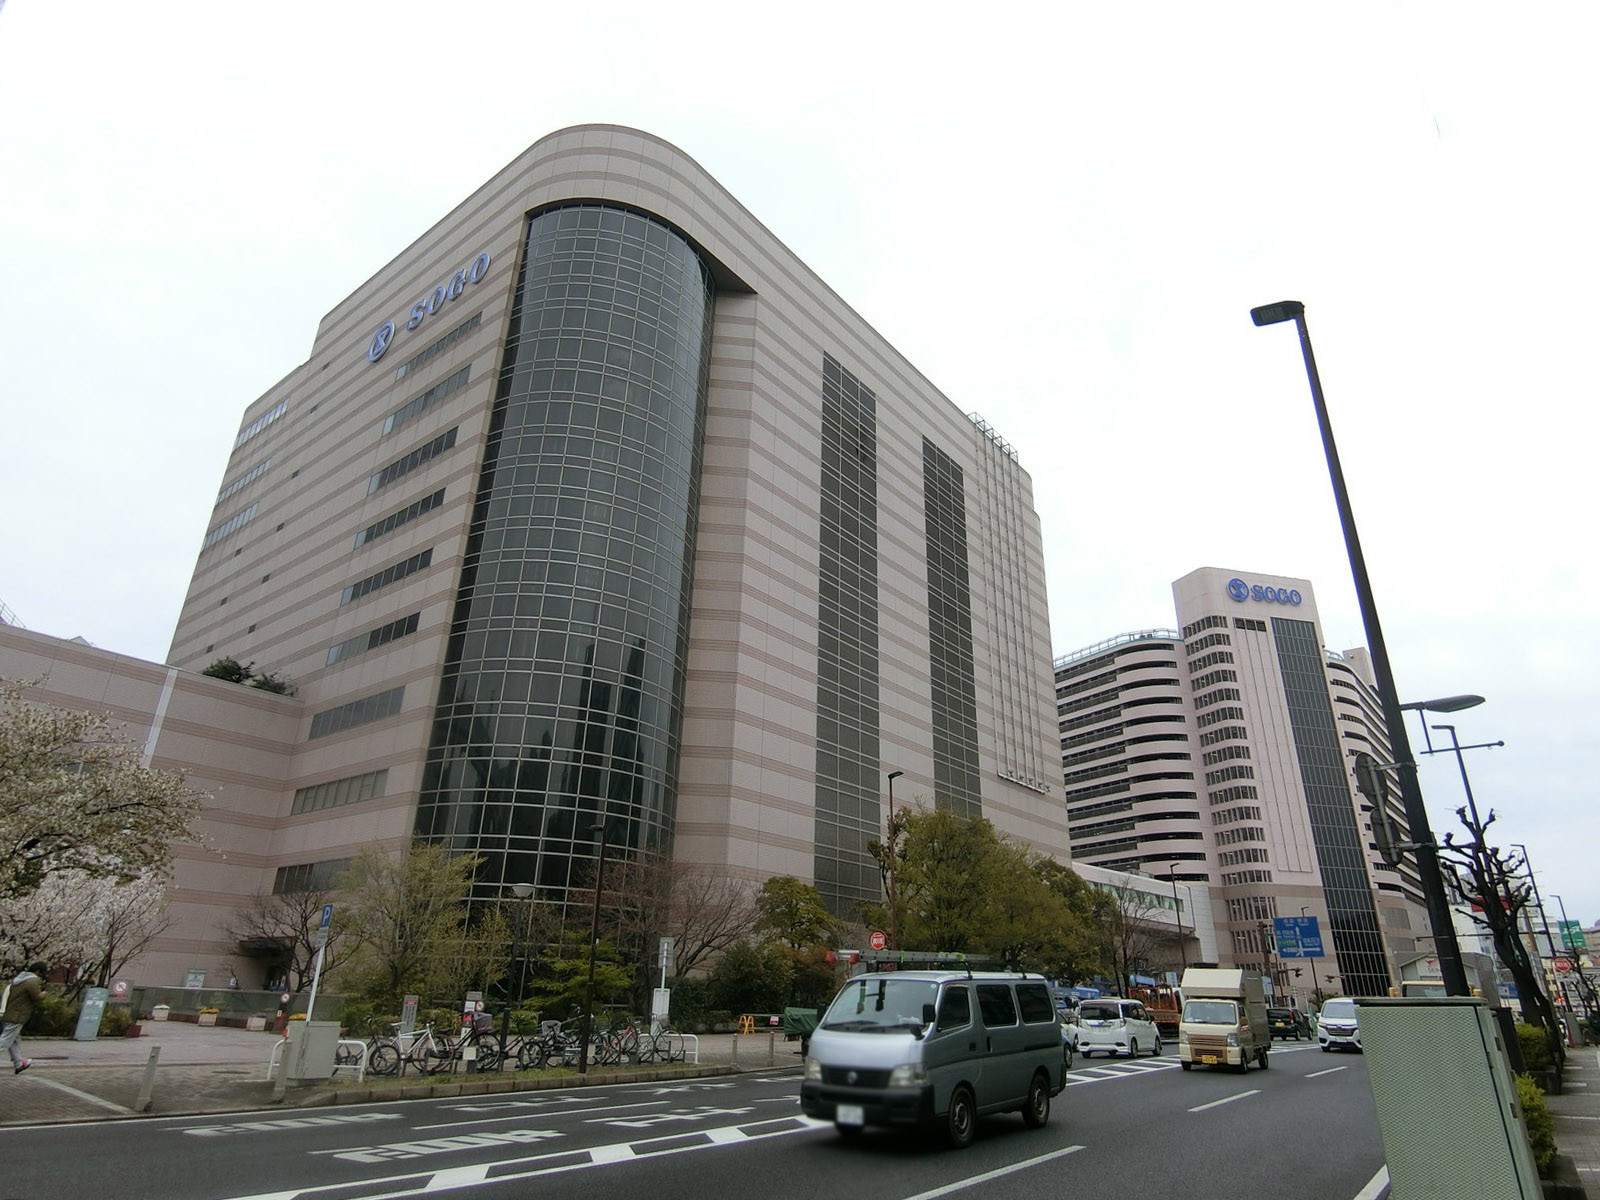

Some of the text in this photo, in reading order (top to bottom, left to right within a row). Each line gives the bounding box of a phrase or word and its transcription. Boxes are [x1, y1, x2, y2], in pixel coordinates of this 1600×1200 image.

[407, 253, 491, 331] SOGO
[1251, 584, 1302, 606] SOGO
[322, 906, 331, 925] P
